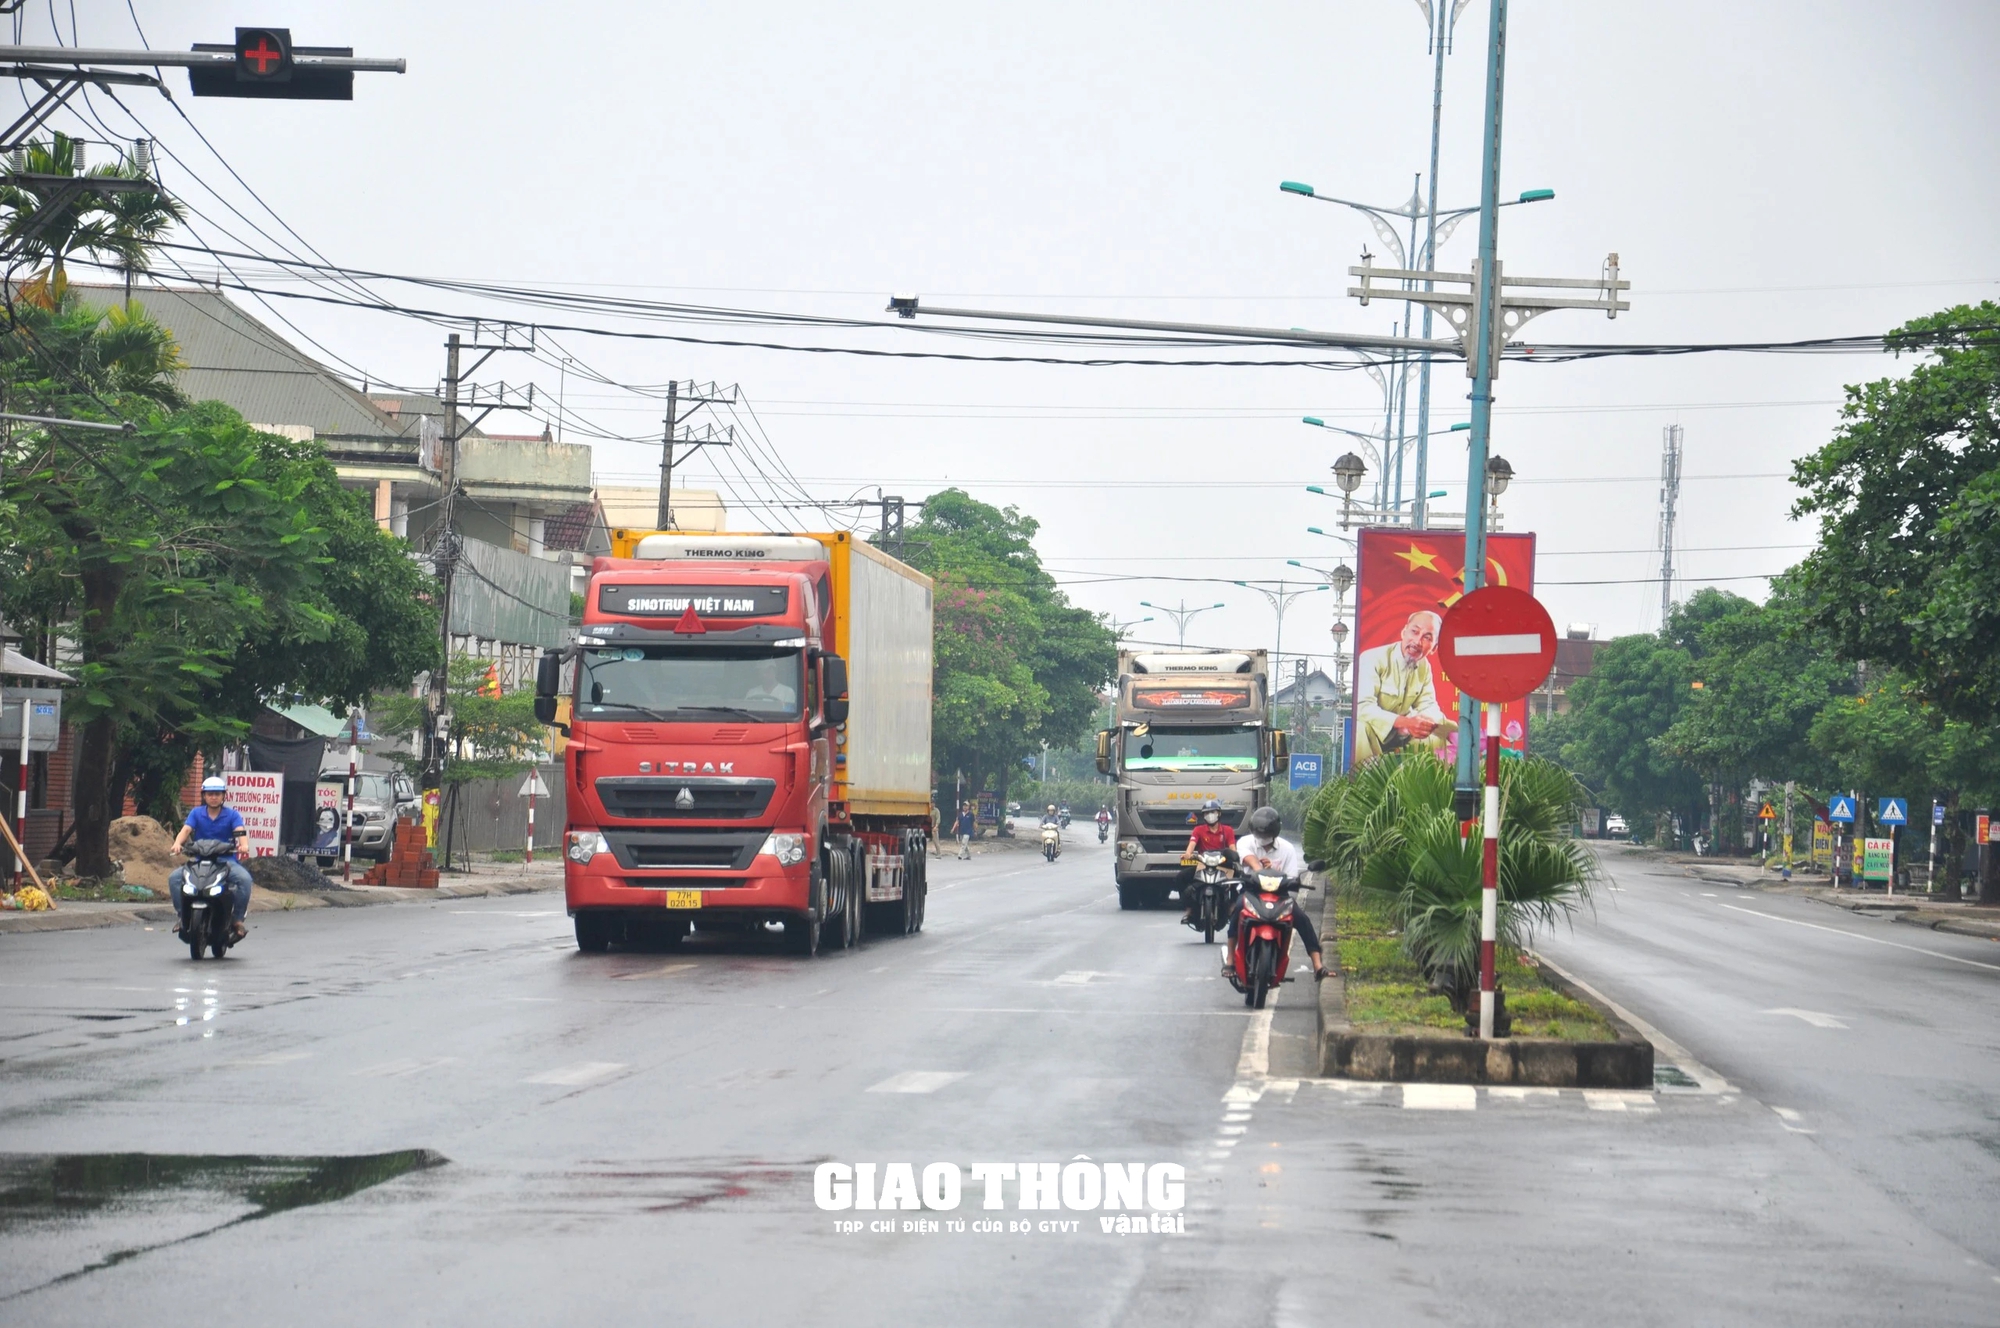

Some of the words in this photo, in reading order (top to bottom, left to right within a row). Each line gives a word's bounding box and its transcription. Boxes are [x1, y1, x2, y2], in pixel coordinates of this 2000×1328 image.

[685, 549, 733, 557] THERMO
[628, 598, 691, 611] SINOTRUK
[692, 597, 720, 613] VIỆT
[723, 599, 754, 611] NAM
[639, 762, 734, 773] SITRAK
[1295, 761, 1317, 771] ACB
[227, 776, 275, 788] HONDA
[318, 788, 336, 797] TÓC
[245, 818, 251, 826] XE
[252, 818, 258, 826] GA
[263, 818, 269, 827] XE
[249, 829, 274, 840] YAMAHA
[676, 891, 692, 899] 77H
[670, 900, 698, 908] 020.15
